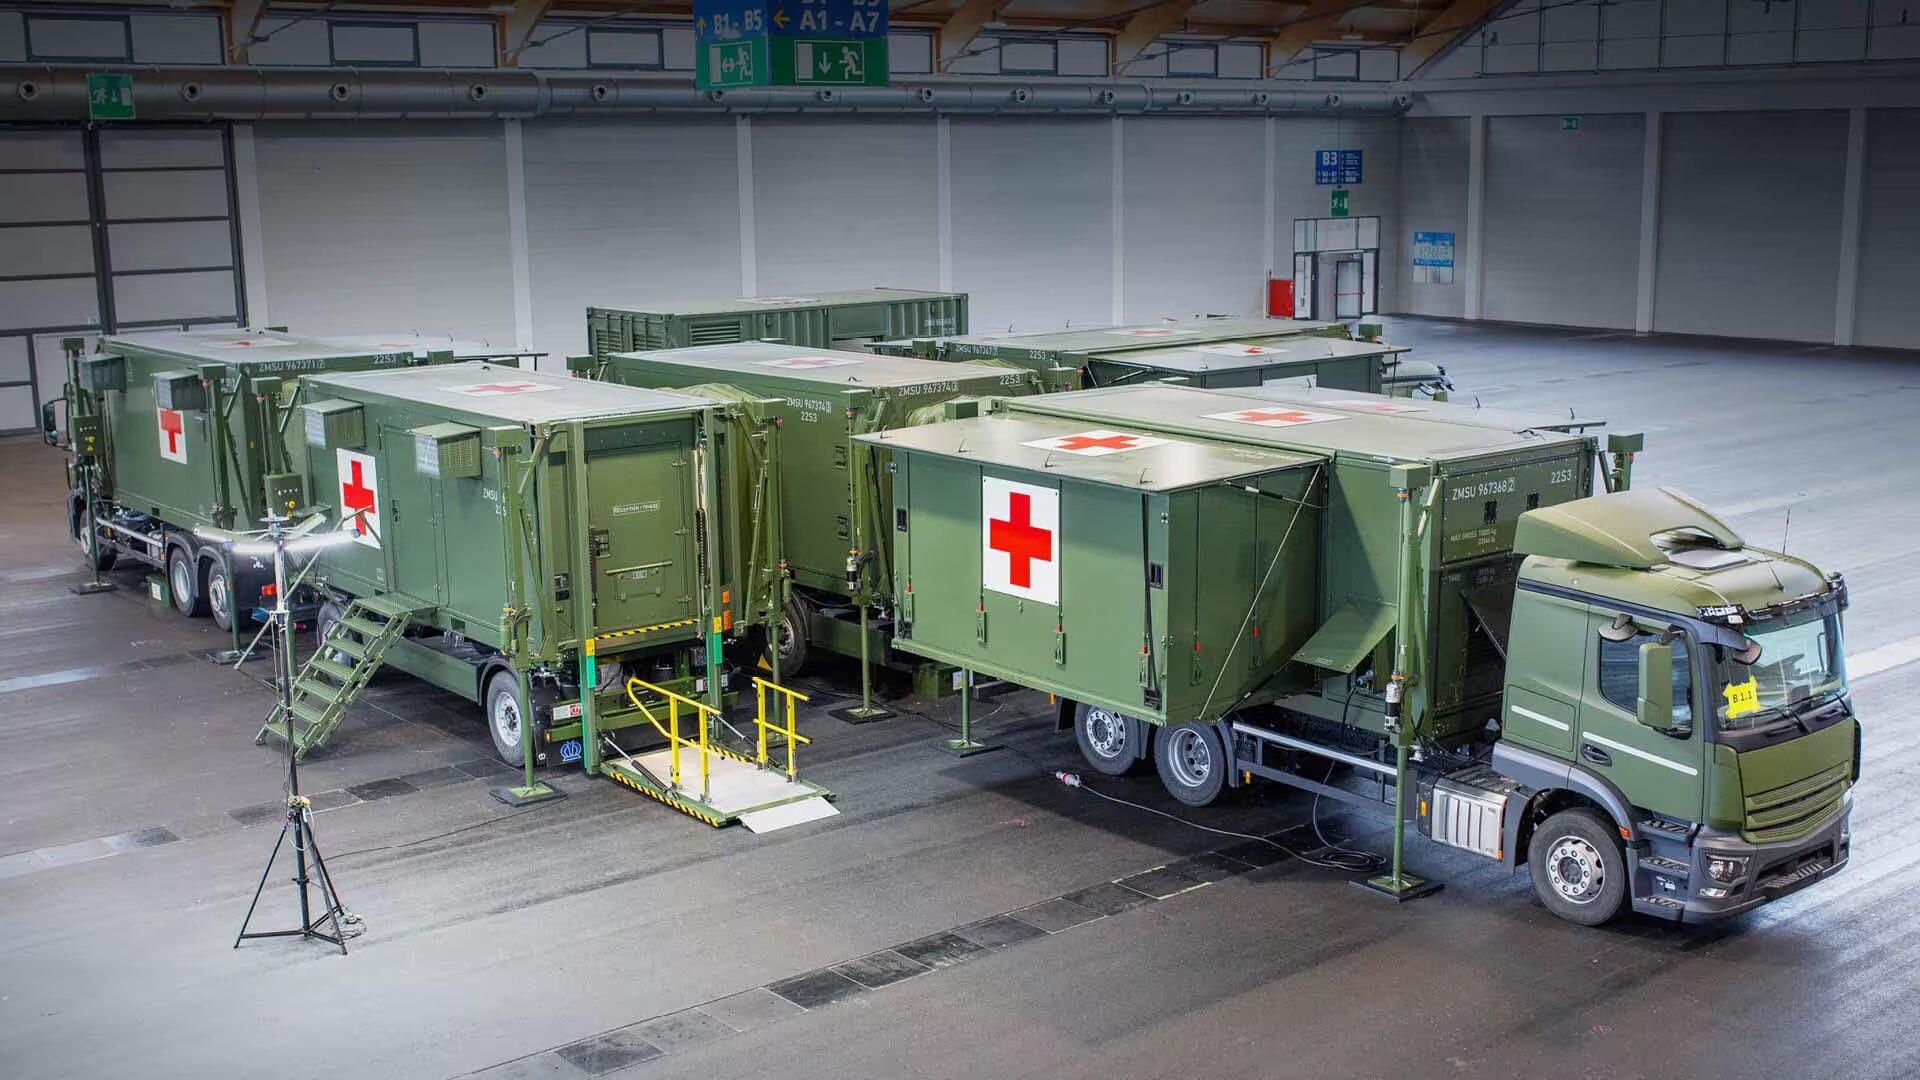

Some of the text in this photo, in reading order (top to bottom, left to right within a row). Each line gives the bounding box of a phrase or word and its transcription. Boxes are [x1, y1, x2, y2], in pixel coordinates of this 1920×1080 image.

[713, 14, 729, 34] B1
[744, 10, 762, 31] B5
[799, 10, 828, 31] A1
[848, 11, 880, 33] A7
[1322, 151, 1338, 166] B3
[259, 363, 284, 372] ZMSU
[898, 386, 921, 397] ZMSU
[786, 397, 804, 409] ZMSU
[1452, 485, 1477, 501] ZMSU
